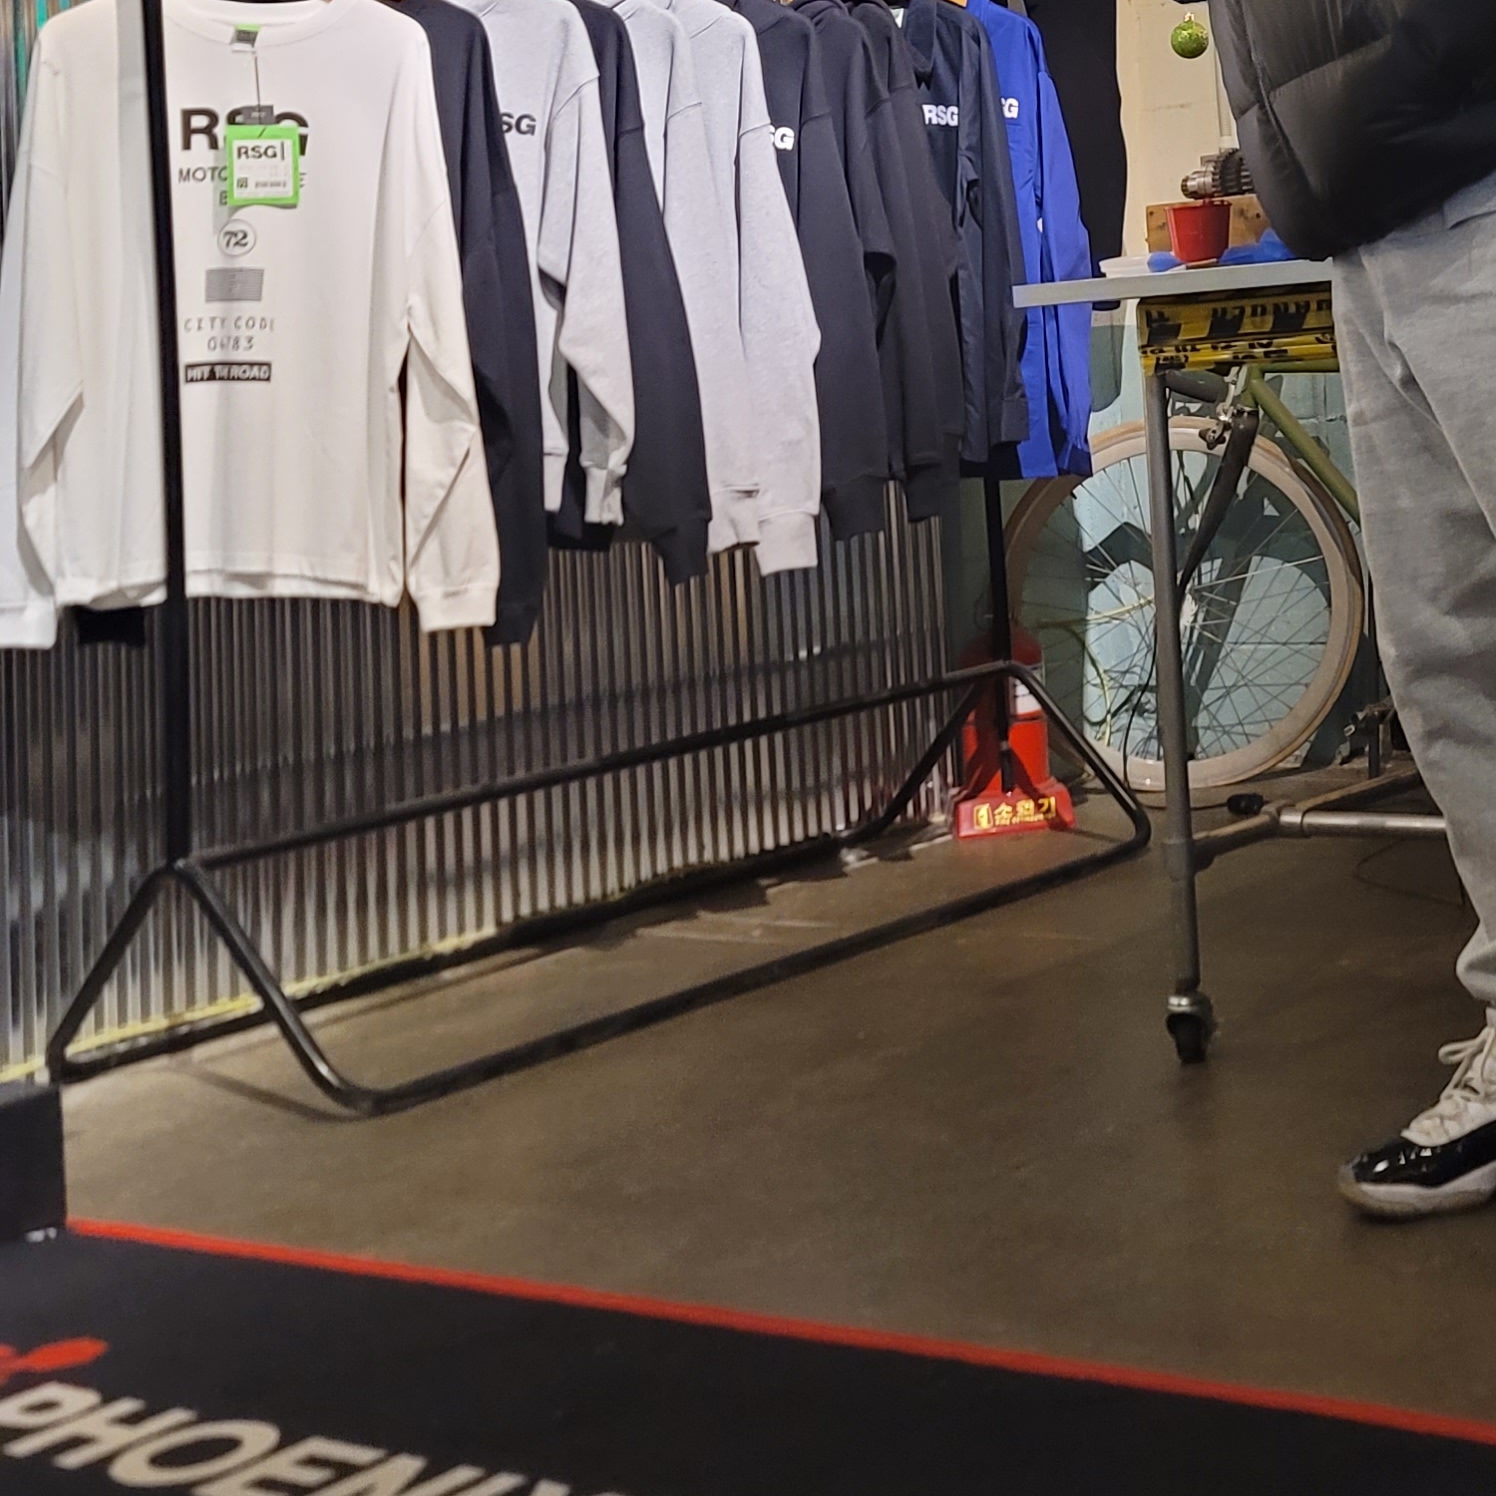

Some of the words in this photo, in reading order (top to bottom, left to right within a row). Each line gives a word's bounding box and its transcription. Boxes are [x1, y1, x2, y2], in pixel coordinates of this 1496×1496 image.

[500, 111, 537, 137] SG
[921, 104, 959, 127] RSG
[236, 145, 278, 160] RSG
[222, 229, 249, 249] 72
